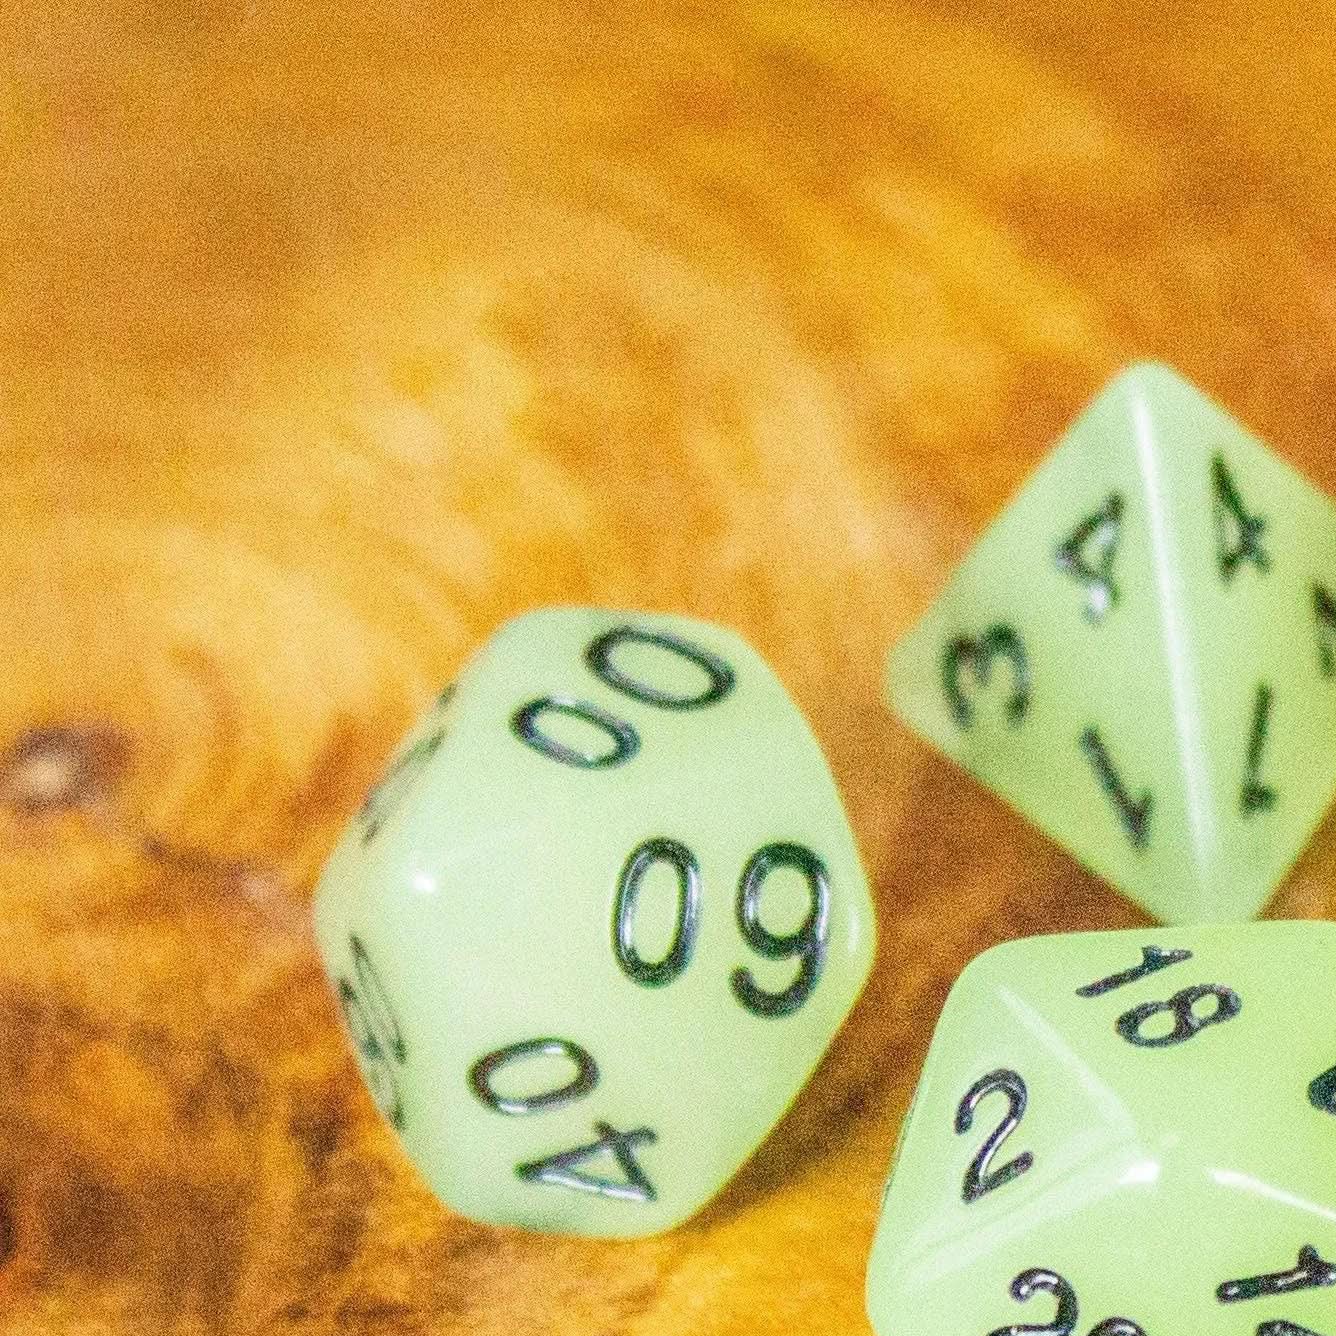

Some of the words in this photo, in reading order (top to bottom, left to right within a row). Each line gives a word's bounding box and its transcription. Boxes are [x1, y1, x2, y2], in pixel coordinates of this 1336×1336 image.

[1057, 490, 1125, 624] 4
[1211, 452, 1271, 583] 4
[509, 624, 737, 770] 00
[941, 624, 1032, 730] 3
[1075, 945, 1241, 1049] 18
[955, 1068, 1033, 1203] 2
